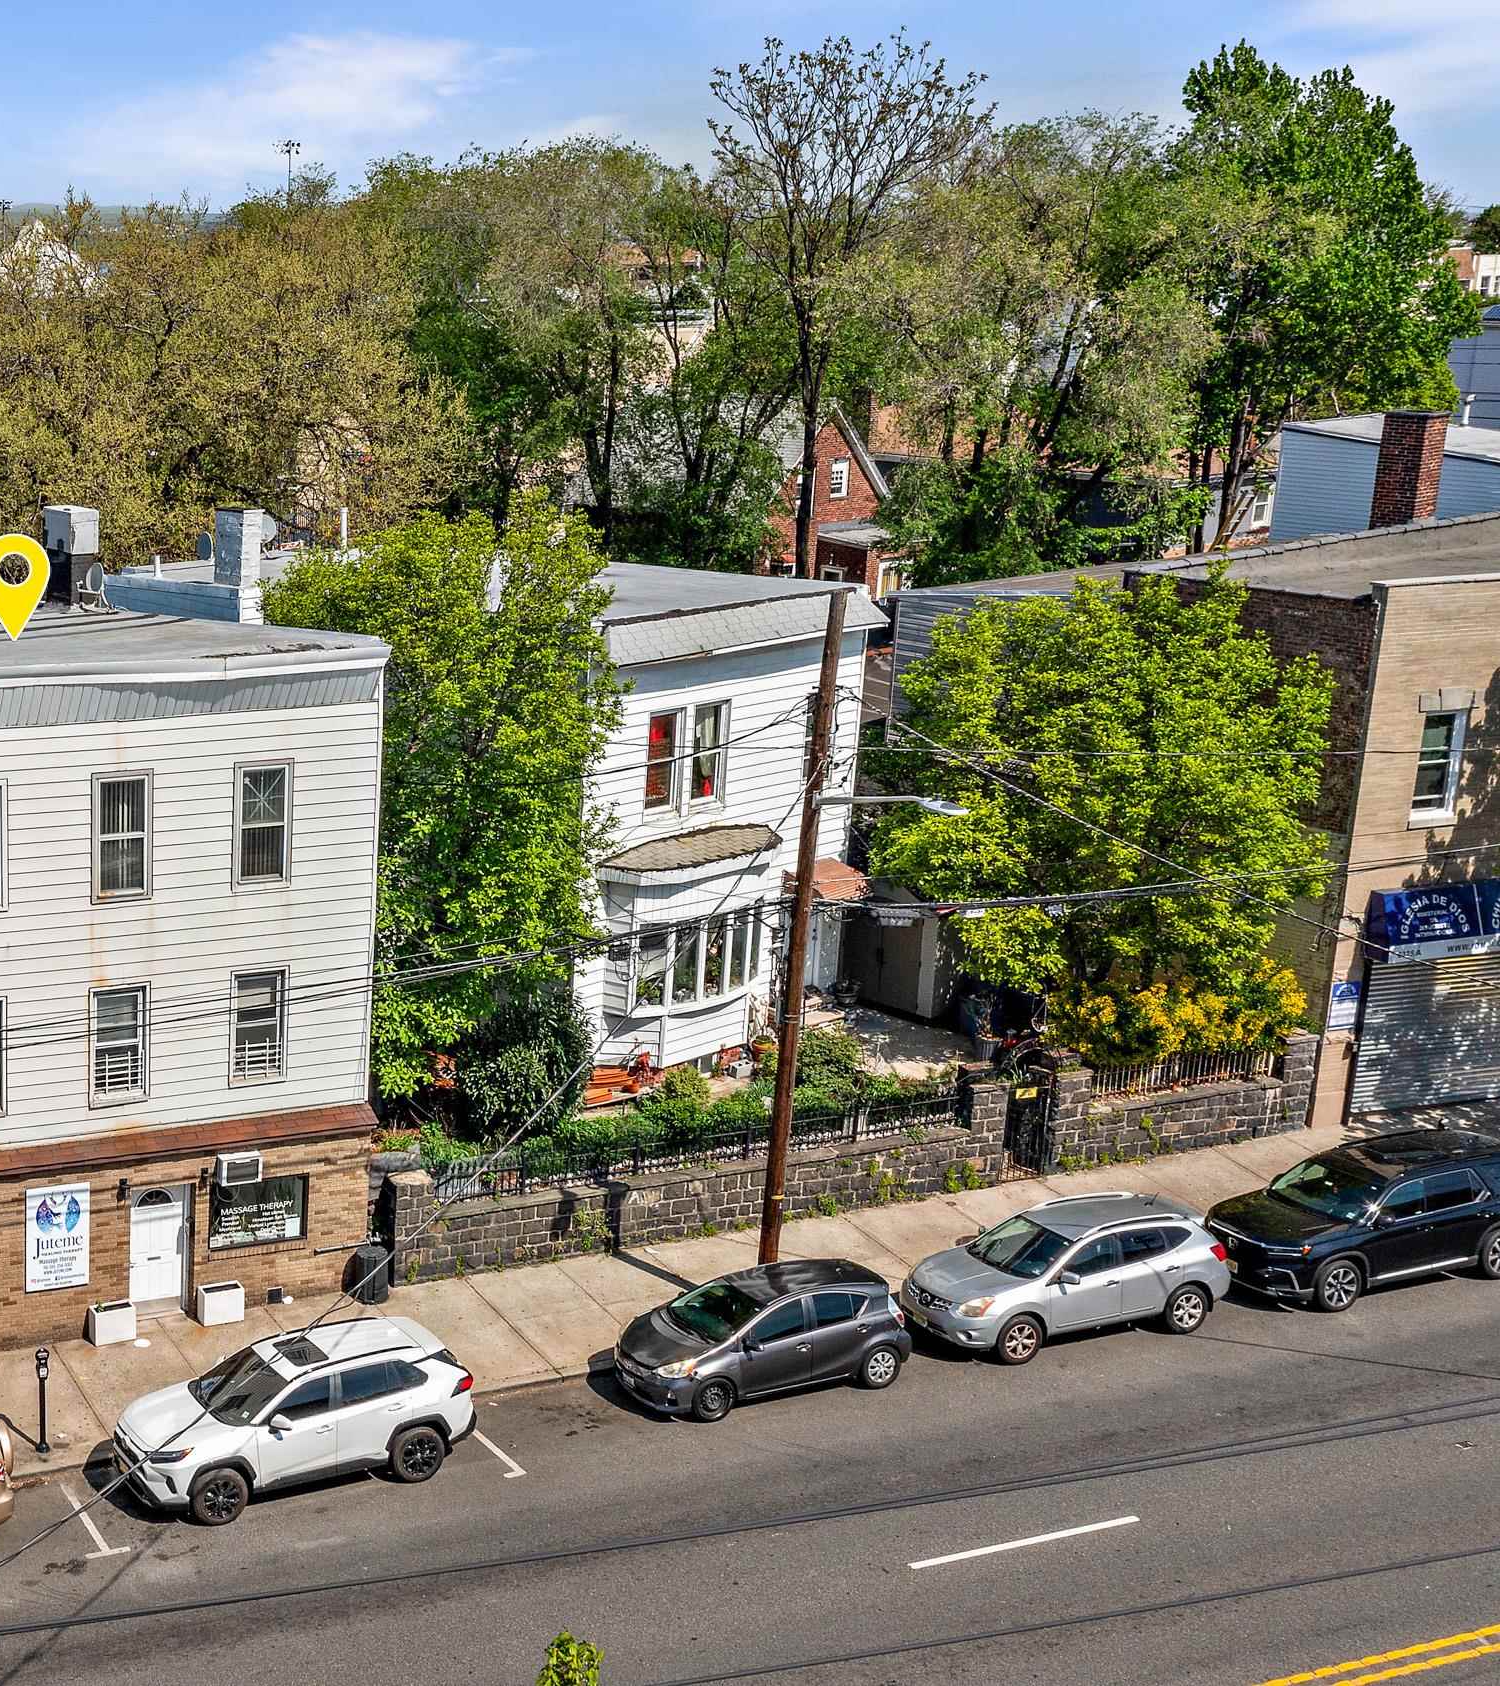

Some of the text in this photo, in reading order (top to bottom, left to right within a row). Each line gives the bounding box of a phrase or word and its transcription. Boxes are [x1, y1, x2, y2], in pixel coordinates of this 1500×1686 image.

[1401, 894, 1470, 939] IGLESIA DE DIOS
[220, 1200, 294, 1216] MASSAGE THERAPY
[32, 1235, 84, 1260] Juteme
